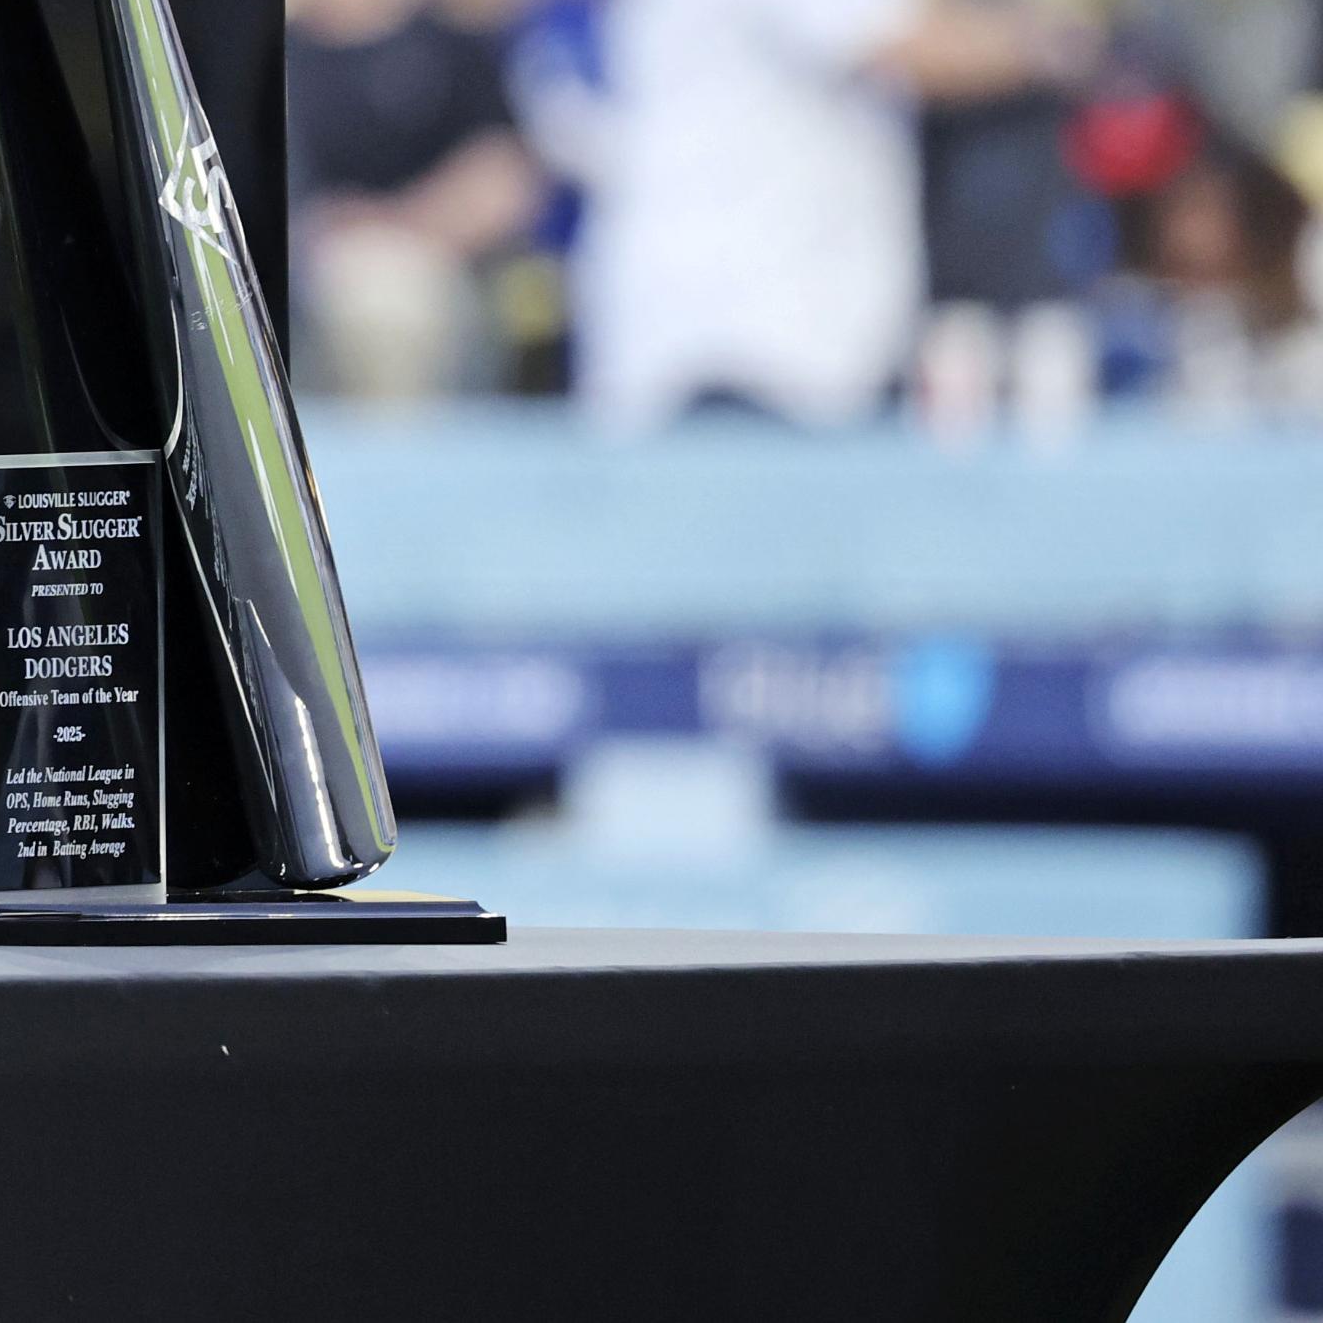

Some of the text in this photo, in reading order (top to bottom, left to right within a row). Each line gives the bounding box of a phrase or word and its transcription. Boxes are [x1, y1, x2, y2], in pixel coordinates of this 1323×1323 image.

[18, 492, 76, 509] LOUISVILLE
[32, 544, 102, 571] AWARD
[31, 582, 103, 597] PRESENTED TO
[7, 623, 129, 649] LOS ANGELES
[24, 655, 113, 679] DODGERS
[50, 689, 80, 705] Team
[82, 688, 94, 704] of
[95, 688, 112, 703] the
[114, 687, 139, 703] Year
[53, 726, 86, 742] -2025-
[6, 763, 135, 784] Led the National League in
[6, 788, 135, 811] OPS, Home Runs, Slugging
[7, 813, 135, 836] Percentage, RBI, Walks.
[17, 838, 126, 859] 2nd in Batting Average
